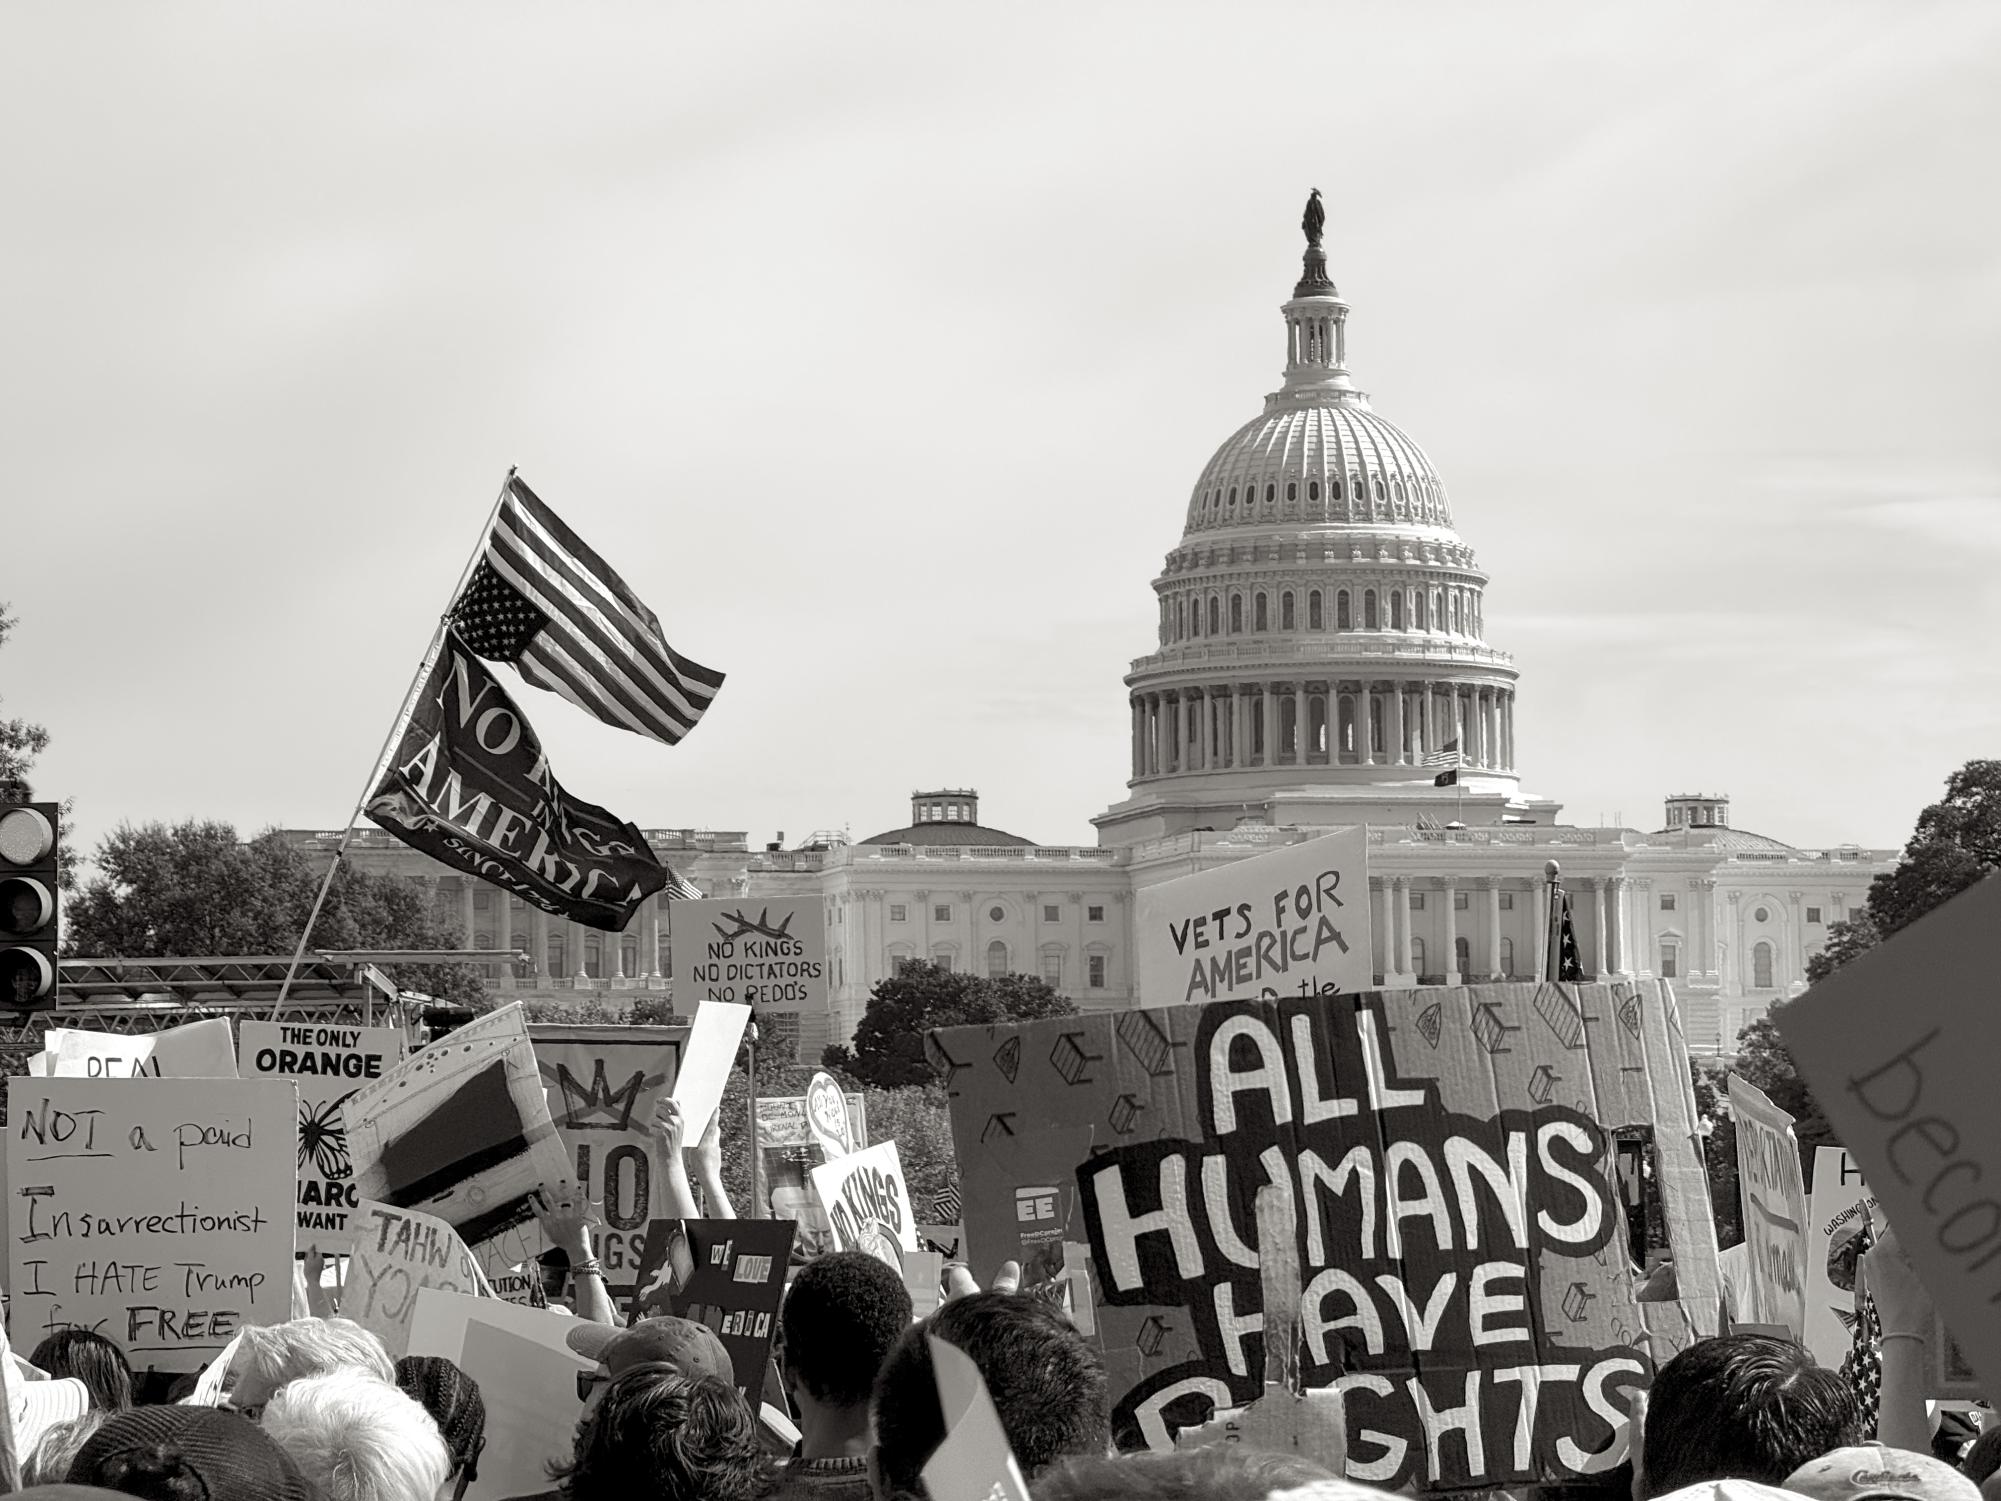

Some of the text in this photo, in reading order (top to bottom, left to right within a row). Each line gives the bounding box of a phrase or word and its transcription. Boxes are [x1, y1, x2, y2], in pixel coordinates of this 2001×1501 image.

[436, 649, 520, 755] NO
[1169, 870, 1344, 956] VETS FOR
[708, 940, 803, 960] NO KINGS
[1185, 914, 1349, 1002] AMERICA
[693, 961, 821, 982] NO DICTATORS
[708, 986, 735, 1002] NO
[280, 1026, 361, 1049] THE ONLY
[255, 1049, 383, 1079] ORANGE
[1208, 1008, 1426, 1134] ALL
[21, 1098, 253, 1171] NOT a paid
[297, 1180, 359, 1208] ARC
[841, 1165, 902, 1235] KINGS
[1093, 1120, 1602, 1292] HUMANS
[297, 1211, 348, 1231] WANT
[1823, 1197, 1880, 1236] WASHINGON
[711, 1240, 733, 1270] WE
[735, 1256, 770, 1281] LOVE
[23, 1260, 265, 1304] I HATE Trump
[125, 1306, 240, 1342] FREE
